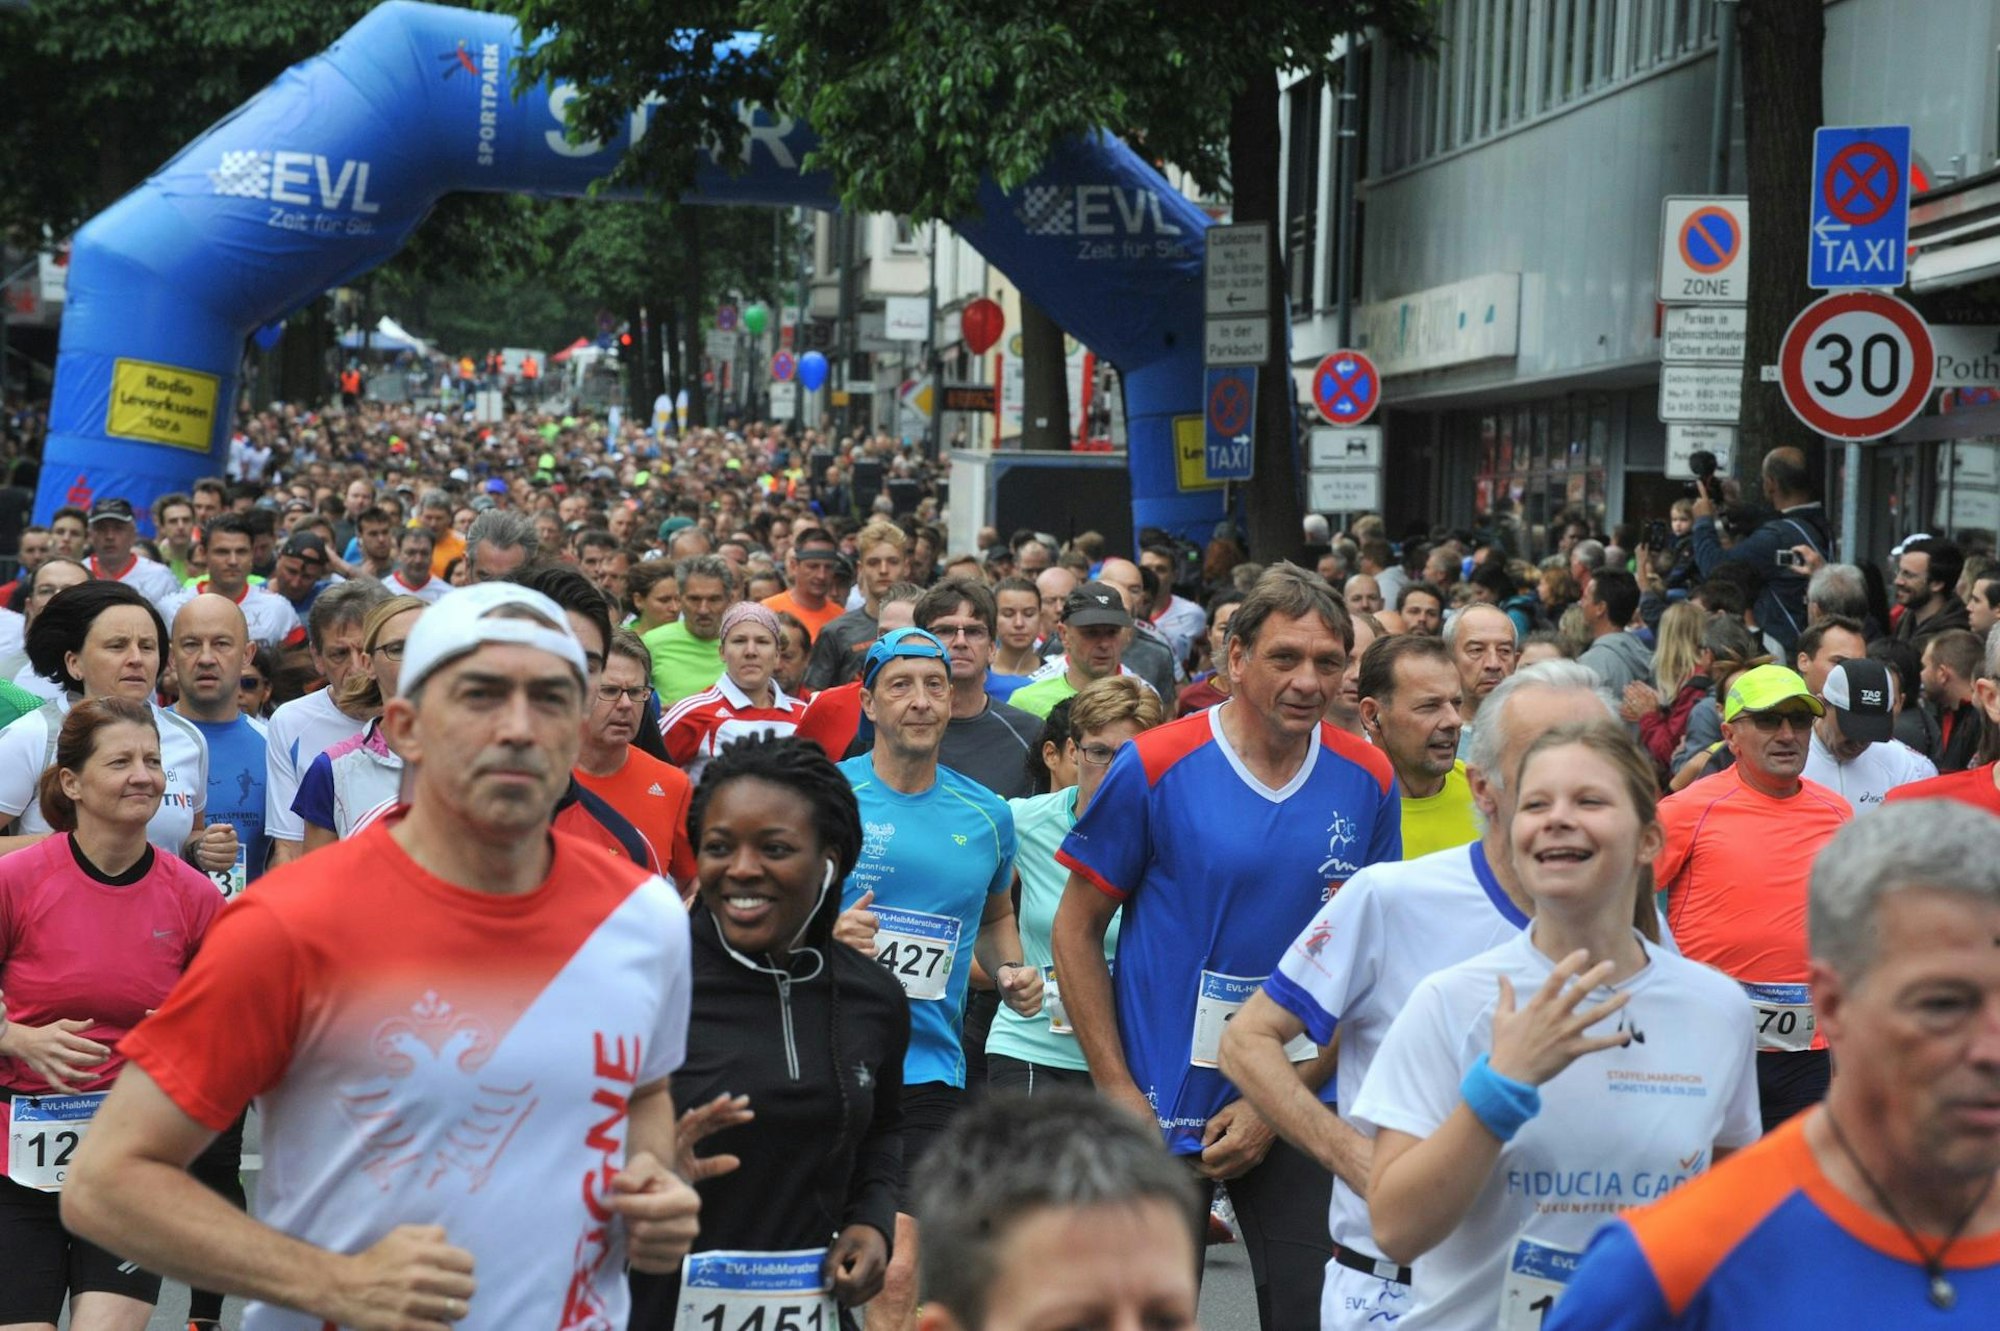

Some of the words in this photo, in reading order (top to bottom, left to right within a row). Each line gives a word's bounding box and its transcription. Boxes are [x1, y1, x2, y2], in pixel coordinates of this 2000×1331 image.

[478, 44, 498, 165] SPORTPARK
[270, 150, 379, 214] EVL
[1076, 185, 1182, 235] EVL
[1077, 240, 1118, 260] Zeit
[1819, 239, 1896, 273] TAXI
[1683, 279, 1730, 296] ZONE
[1814, 333, 1900, 397] 30
[145, 375, 194, 397] Radio
[120, 391, 208, 418] Leverkusen
[1209, 446, 1249, 470] TAXI
[852, 871, 882, 882] Trainer
[1507, 1170, 1622, 1197] FIDUCIA
